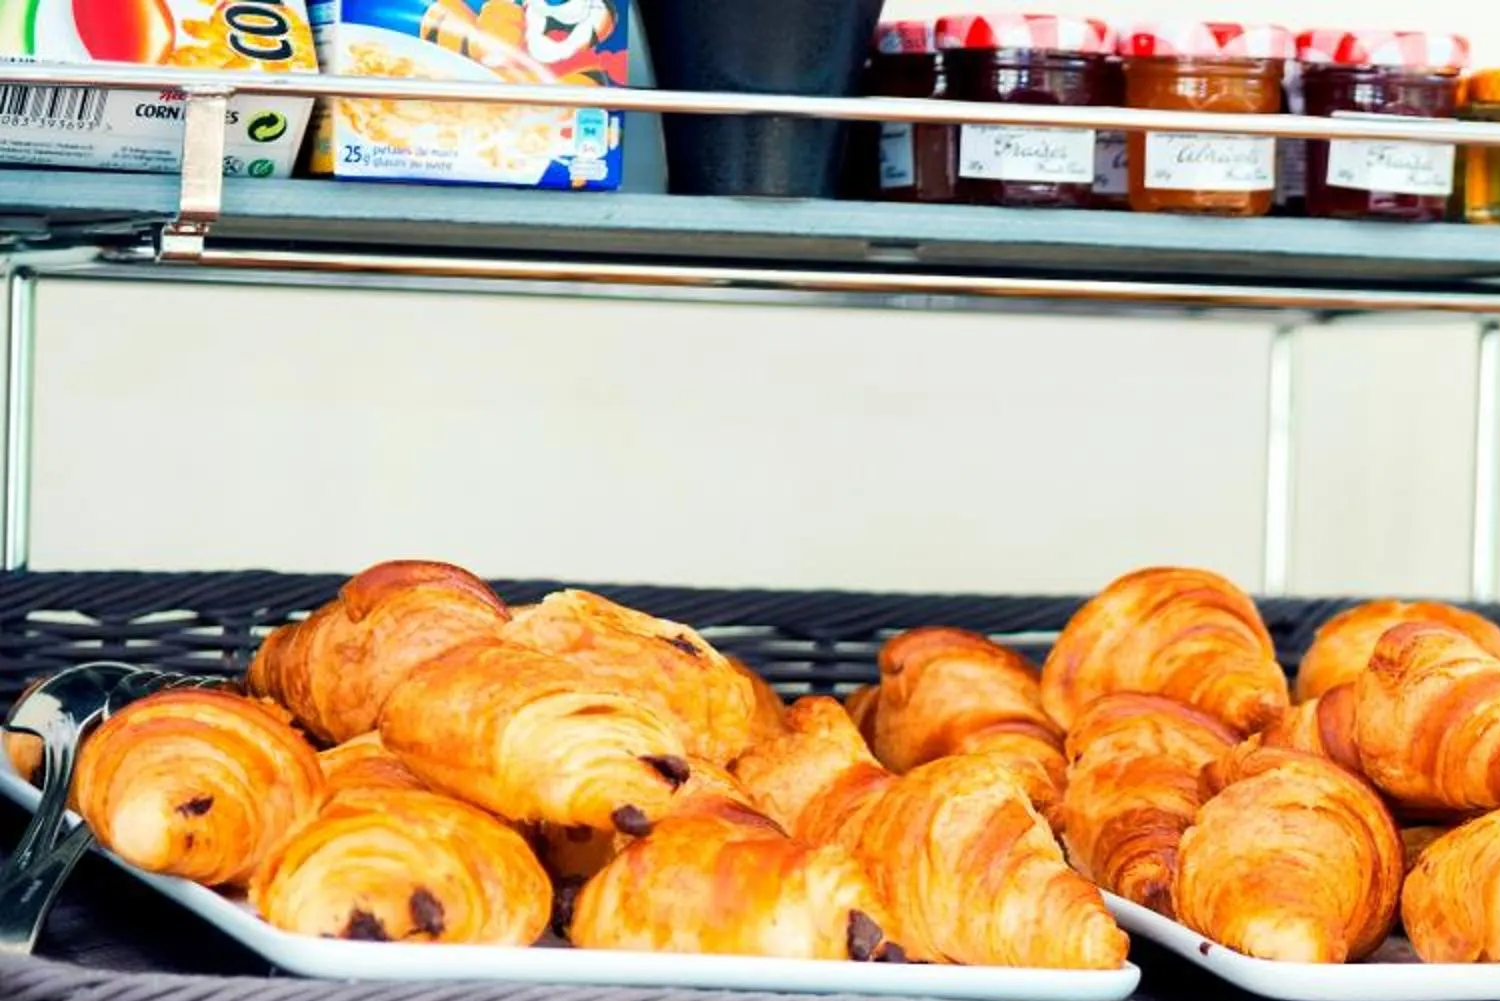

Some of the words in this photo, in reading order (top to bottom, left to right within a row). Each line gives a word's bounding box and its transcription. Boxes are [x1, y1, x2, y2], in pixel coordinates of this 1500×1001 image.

[225, 0, 293, 60] CO
[135, 103, 180, 120] CORN
[343, 145, 362, 163] 25
